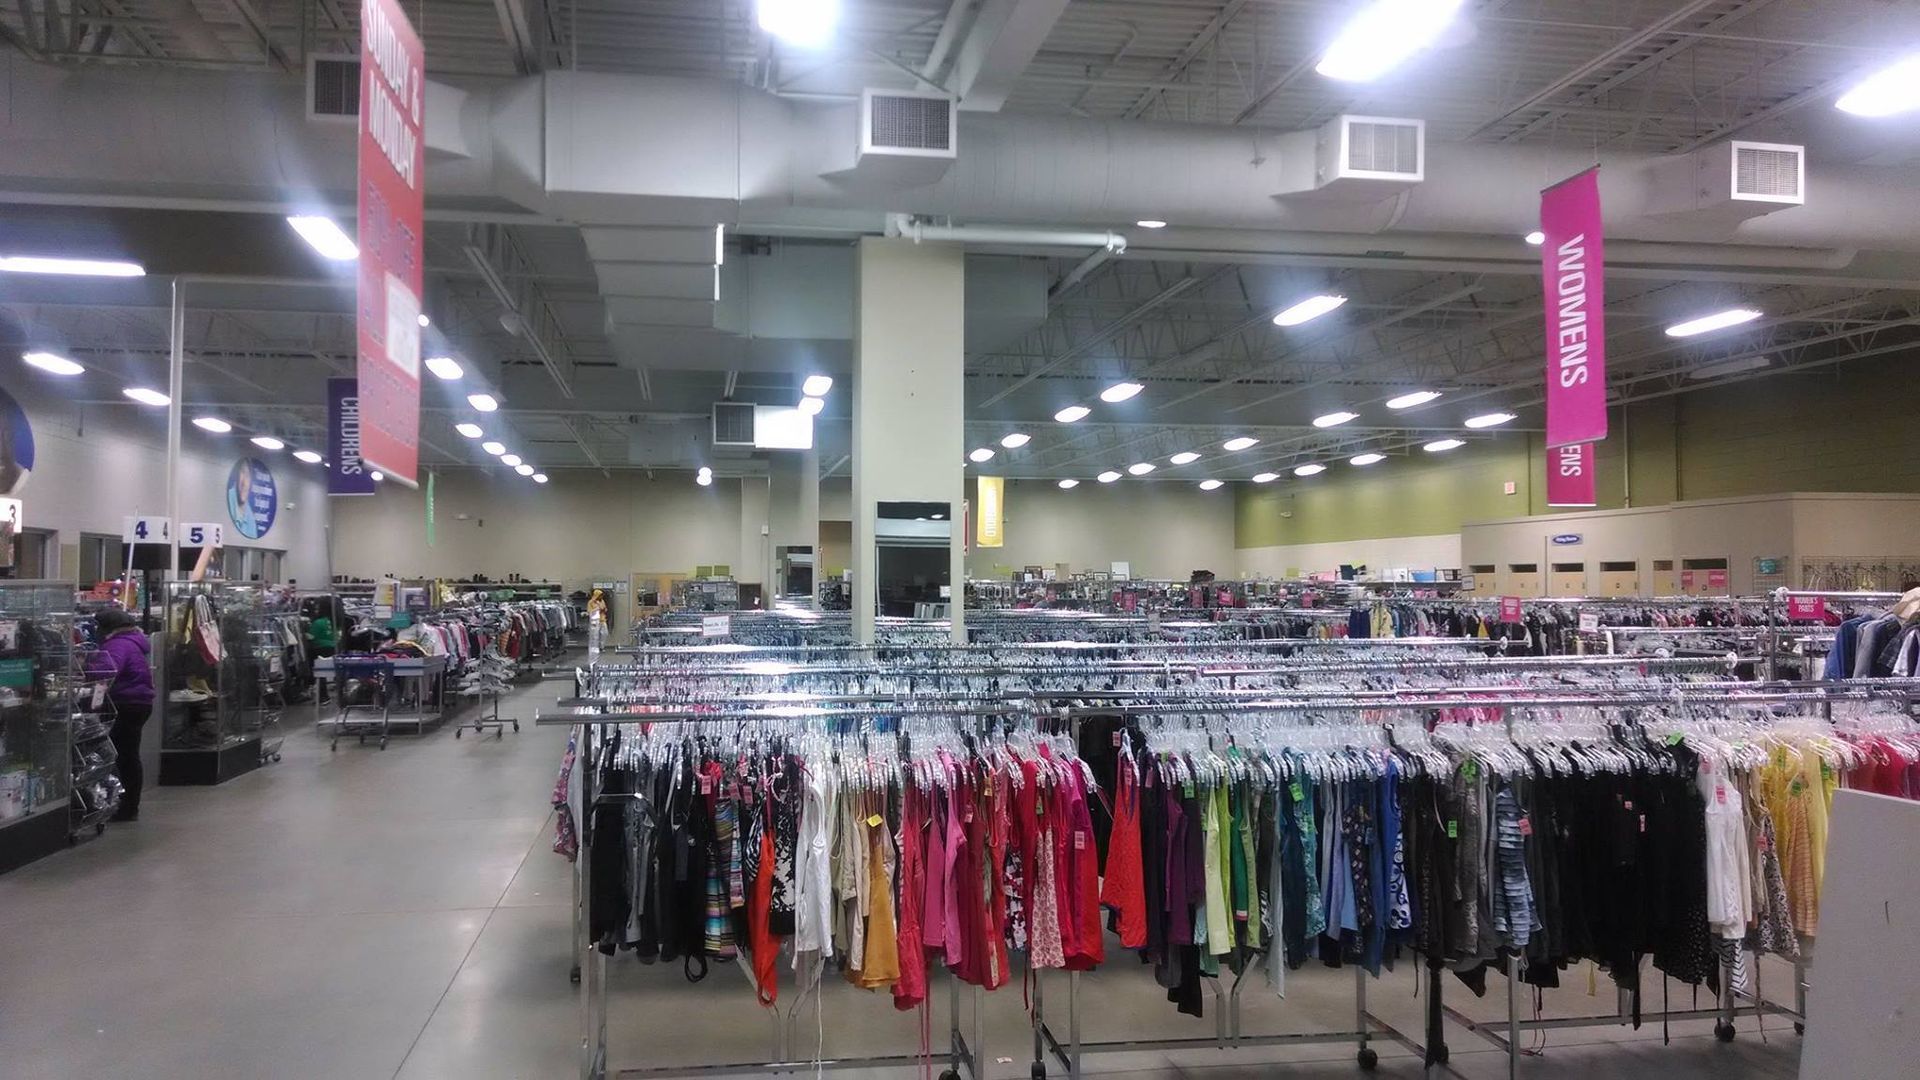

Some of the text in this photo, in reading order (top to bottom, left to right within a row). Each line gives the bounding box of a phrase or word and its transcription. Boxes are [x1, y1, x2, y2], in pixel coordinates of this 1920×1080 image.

[366, 0, 420, 127] SUNDAY &
[369, 69, 416, 190] MONDAY
[1557, 233, 1589, 388] WOMENS
[135, 521, 148, 539] 4
[162, 521, 169, 540] 4
[190, 527, 204, 544] 5
